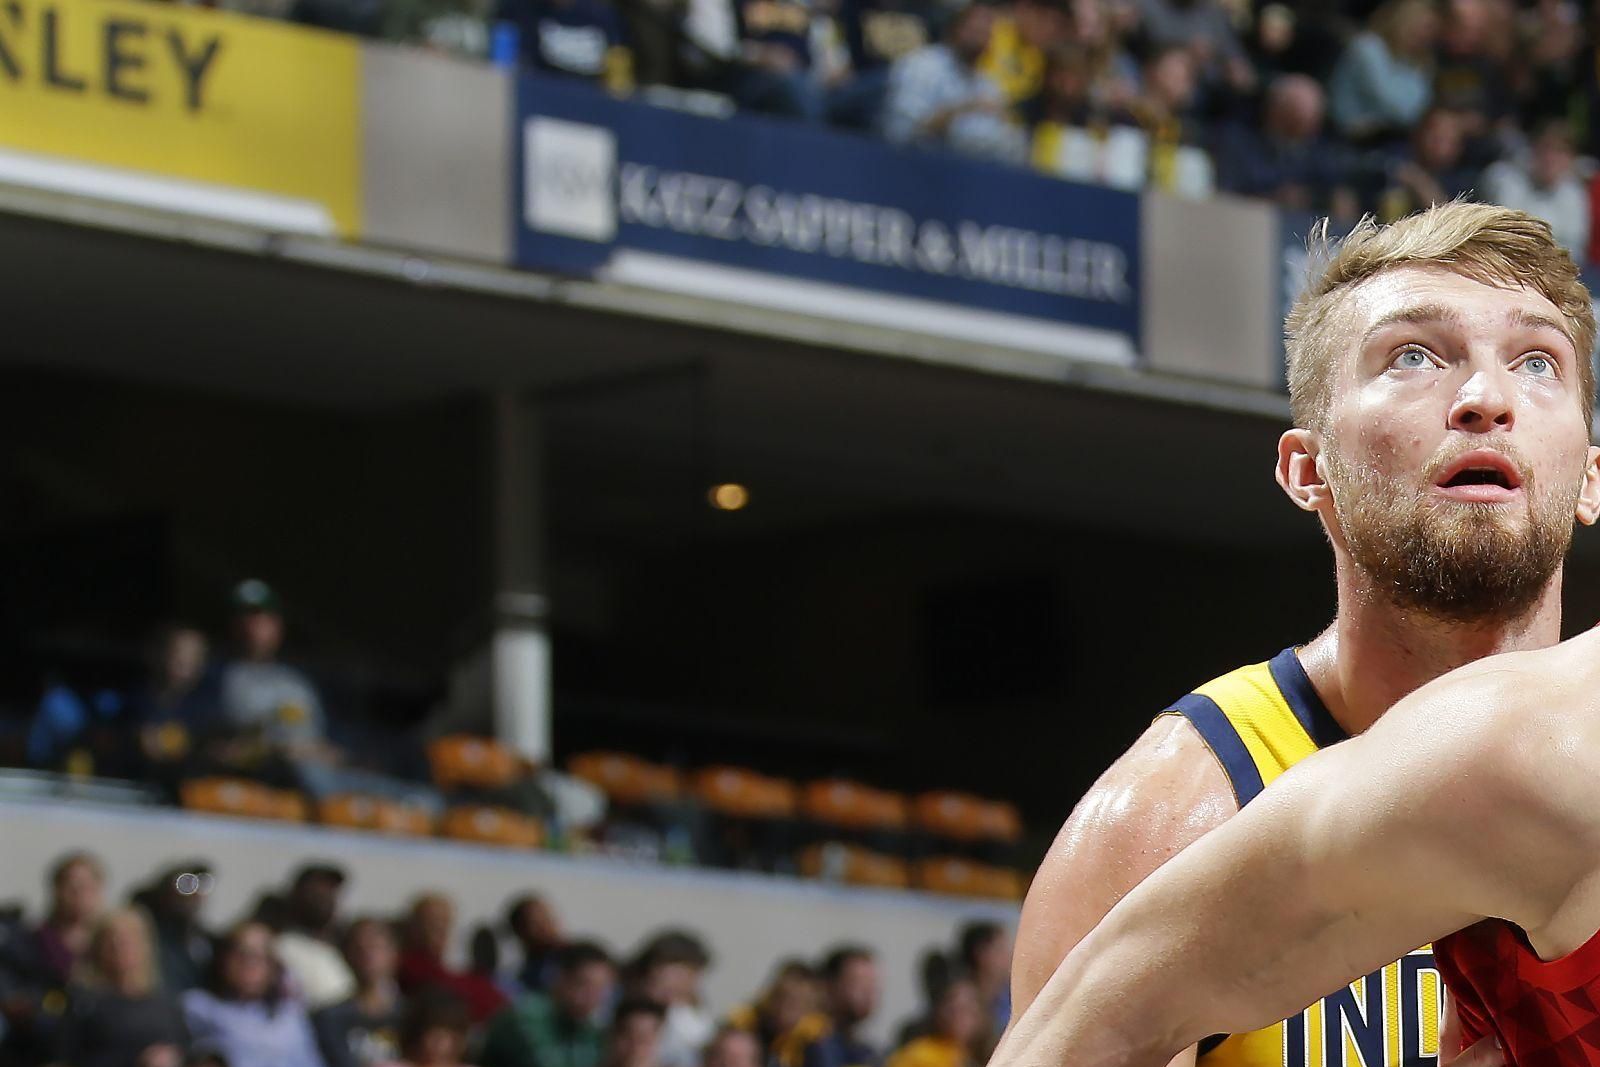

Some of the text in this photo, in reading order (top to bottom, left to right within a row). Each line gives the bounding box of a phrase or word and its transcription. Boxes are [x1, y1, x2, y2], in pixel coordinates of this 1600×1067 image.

[619, 162, 742, 241] KATZ
[743, 184, 916, 271] SAPPER
[957, 220, 1132, 303] MILLER
